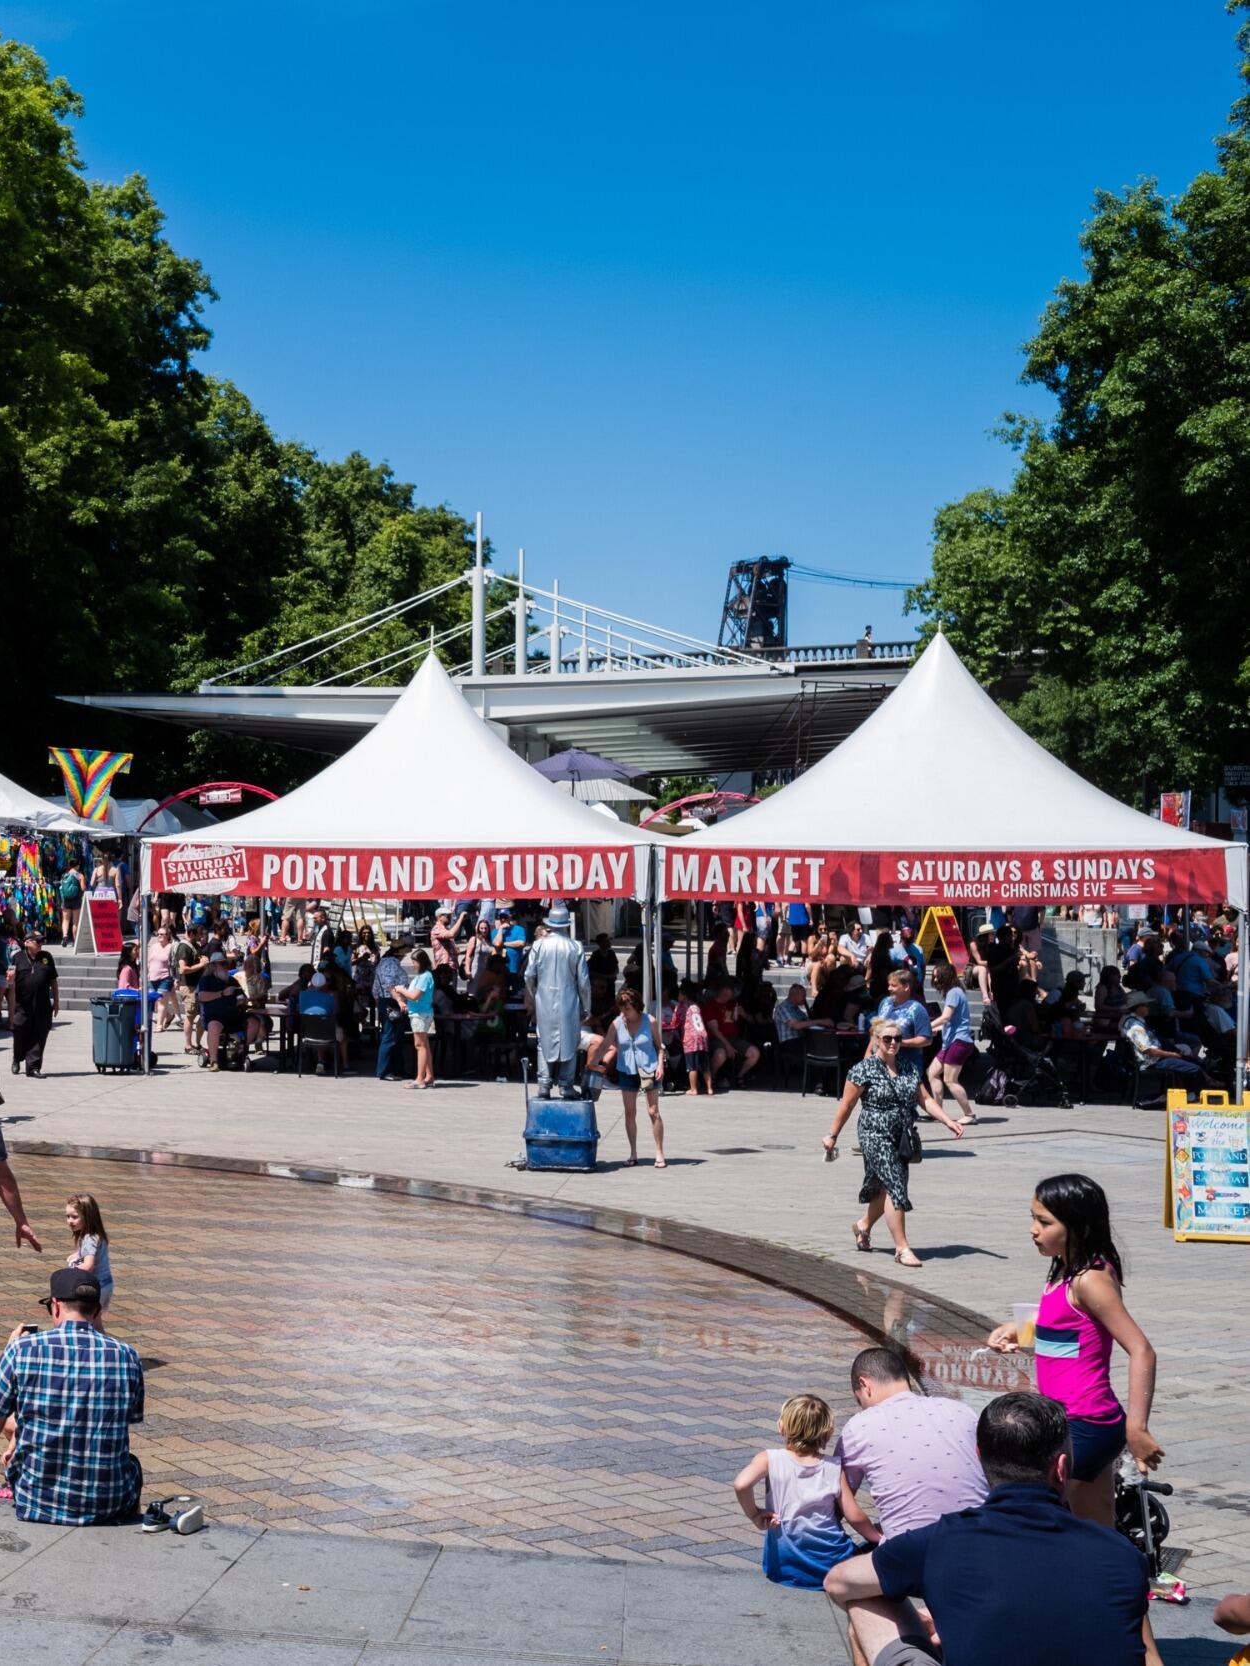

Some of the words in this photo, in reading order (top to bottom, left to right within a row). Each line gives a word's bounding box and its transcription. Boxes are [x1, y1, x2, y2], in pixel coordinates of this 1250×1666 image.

[167, 854, 241, 874] SATURDAY
[262, 853, 434, 892] PORTLAND
[447, 851, 629, 893] SATURDAY
[897, 860, 1021, 882] SATURDAYS
[1031, 859, 1045, 881] &
[1053, 858, 1156, 880] SUNDAYS
[177, 866, 235, 883] MARKET
[671, 853, 825, 897] MARKET
[943, 883, 991, 898] MARCH
[1001, 883, 1079, 898] CHRISTMAS
[1083, 882, 1107, 897] EVE
[1191, 1117, 1245, 1130] Welcome
